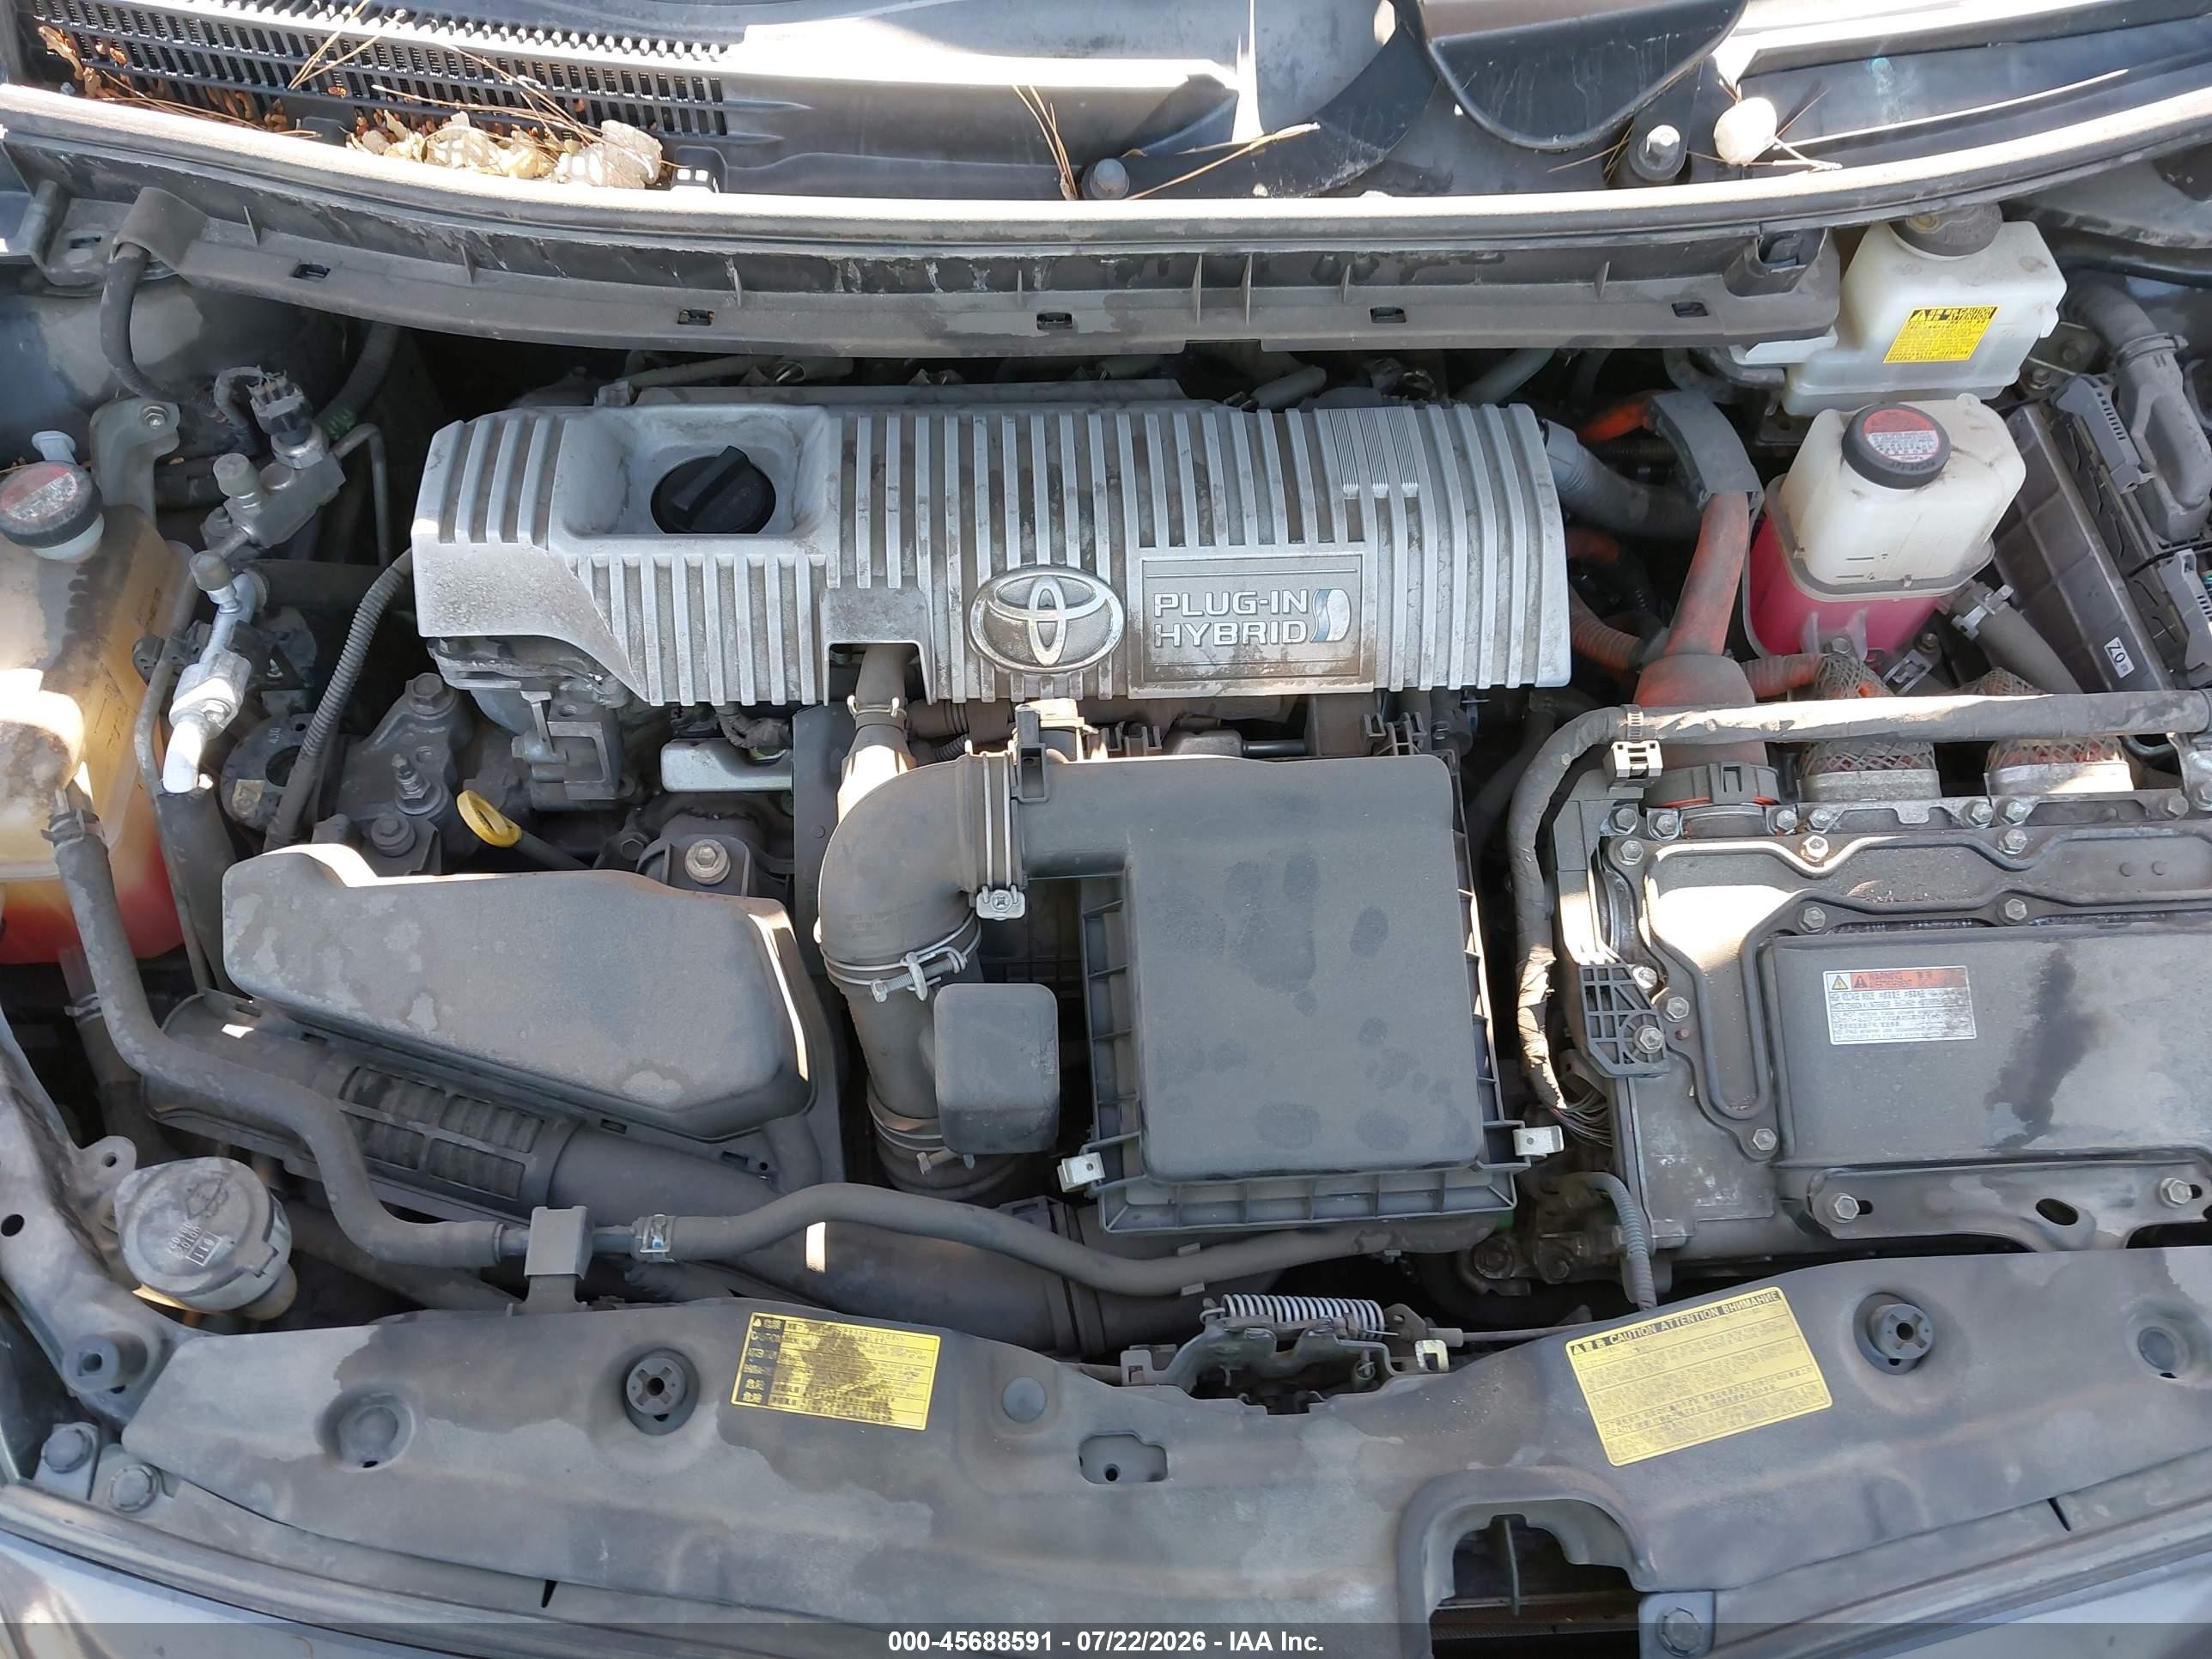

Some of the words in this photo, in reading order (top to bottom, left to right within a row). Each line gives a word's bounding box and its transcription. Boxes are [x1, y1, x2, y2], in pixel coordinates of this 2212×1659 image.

[1153, 588, 1309, 617] PLUG-IN
[1154, 620, 1308, 647] HYBRID
[1609, 1323, 1657, 1345] CAUTION
[1661, 1307, 1720, 1331] ATTENTION
[1722, 1291, 1780, 1315] ВНИМАНИЕ
